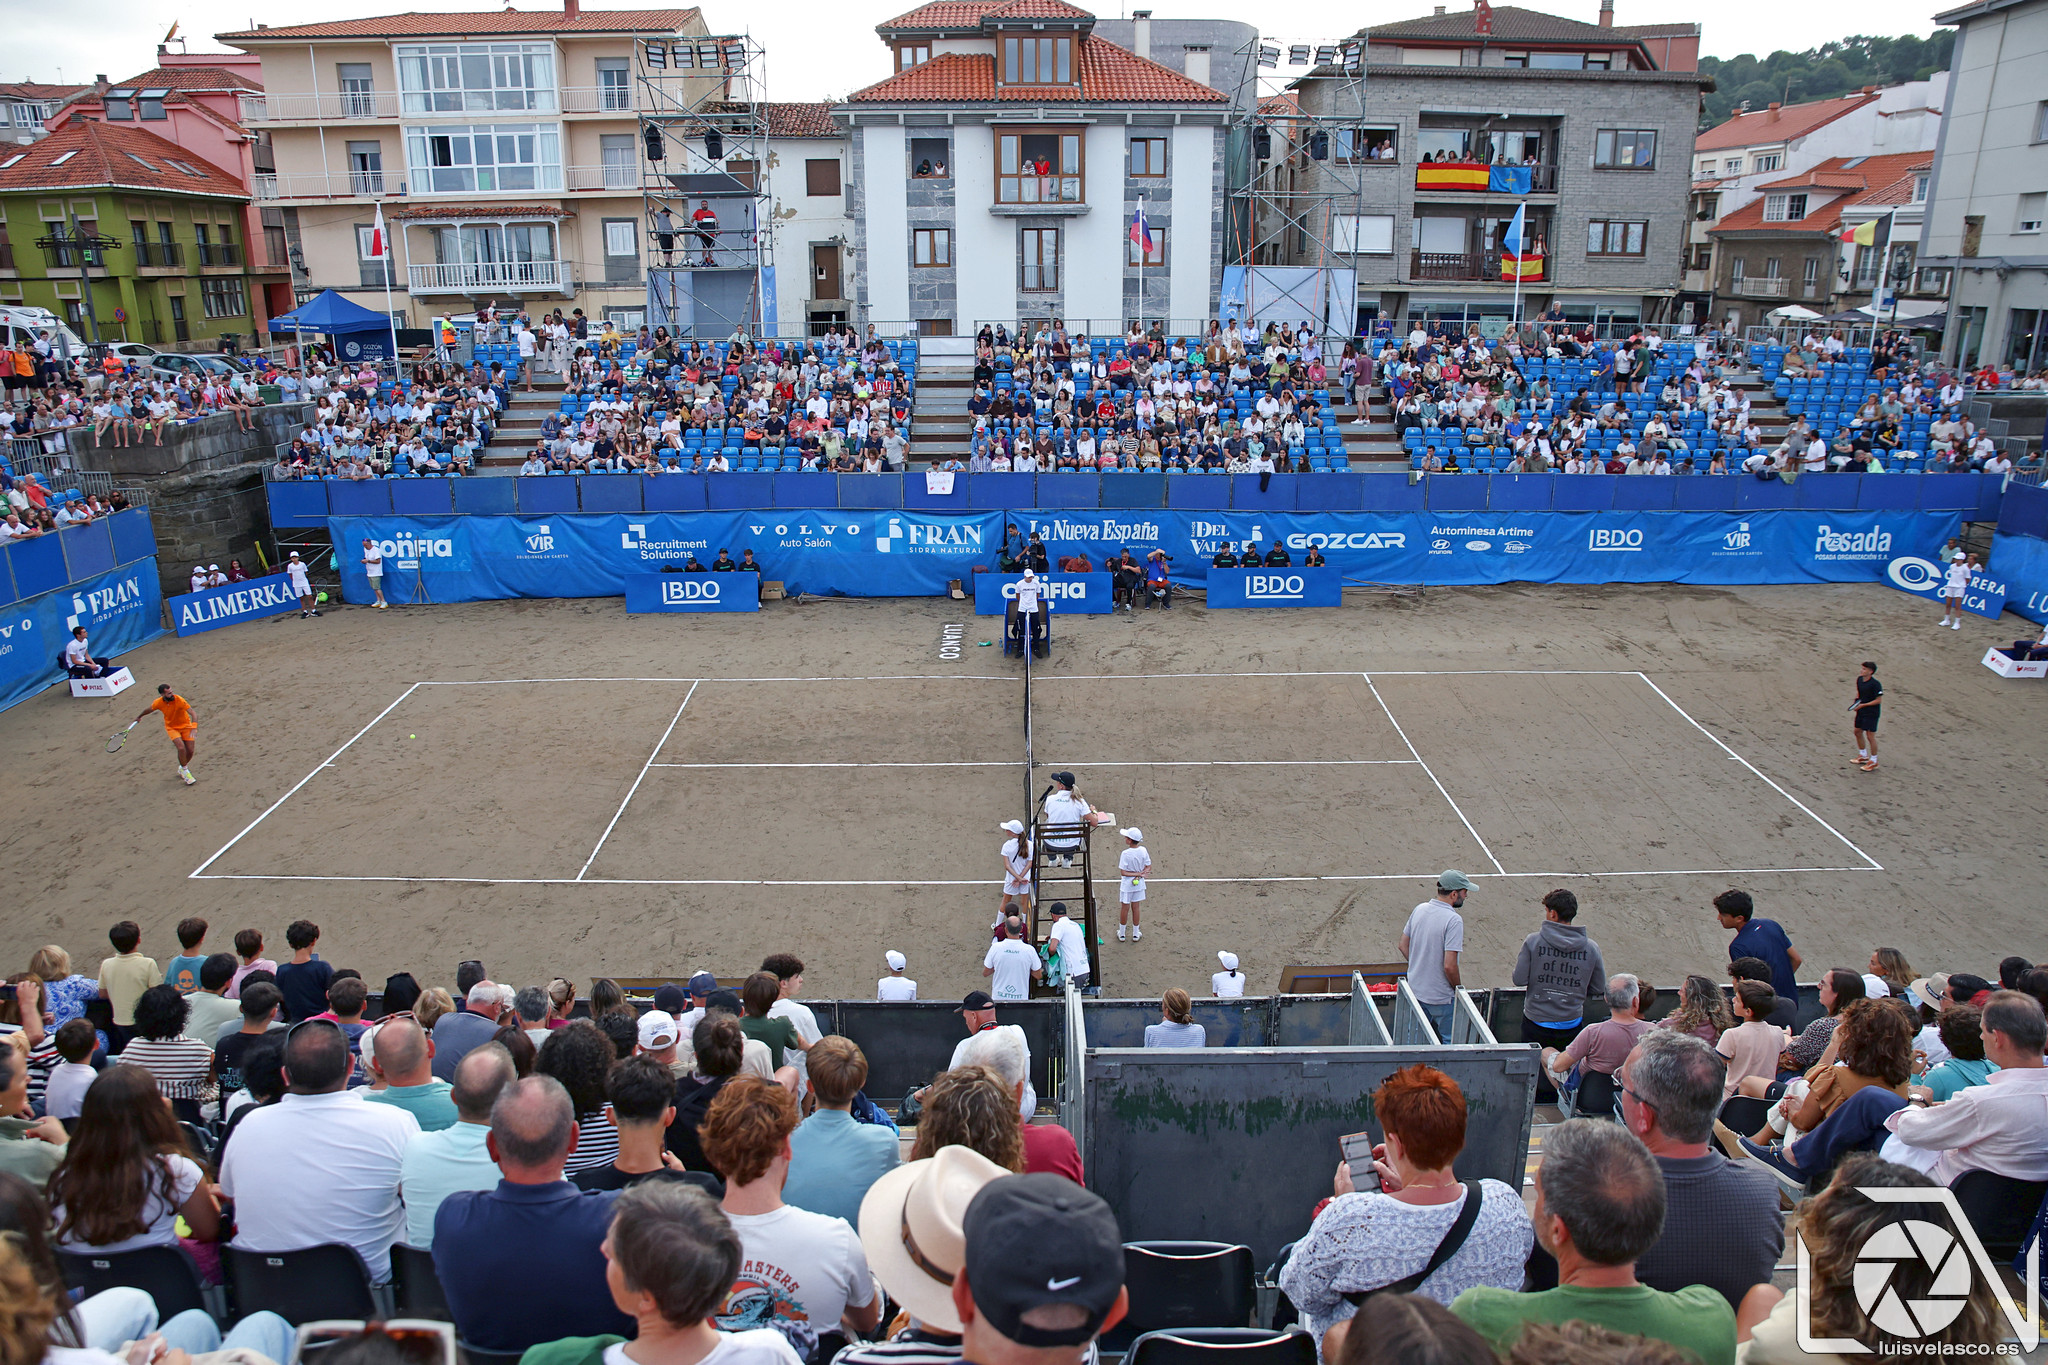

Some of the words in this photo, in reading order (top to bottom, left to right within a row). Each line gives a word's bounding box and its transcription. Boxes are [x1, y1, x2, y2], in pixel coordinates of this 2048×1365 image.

[750, 524, 860, 536] VOLVO
[908, 524, 982, 545] FRAN
[1028, 520, 1050, 541] La
[1052, 519, 1099, 541] Nueva
[1101, 519, 1159, 544] España
[1196, 521, 1230, 538] DEL
[1430, 525, 1496, 536] Autominesa
[1497, 527, 1534, 537] Artime
[1596, 529, 1644, 546] BDO
[639, 539, 707, 550] Recruitment
[779, 539, 802, 548] Auto
[804, 537, 832, 548] Salón
[1190, 539, 1239, 555] VALE
[1286, 532, 1406, 549] GOZCAR
[1815, 525, 1892, 552] Posada
[640, 550, 694, 560] Solutions
[669, 580, 720, 599] BDO
[1253, 575, 1305, 594] BDO
[87, 576, 140, 615] FRAN
[181, 581, 296, 627] ALIMERKA
[938, 623, 964, 660] LUANCO
[1543, 960, 1555, 972] of
[739, 1260, 800, 1294] ASTERS
